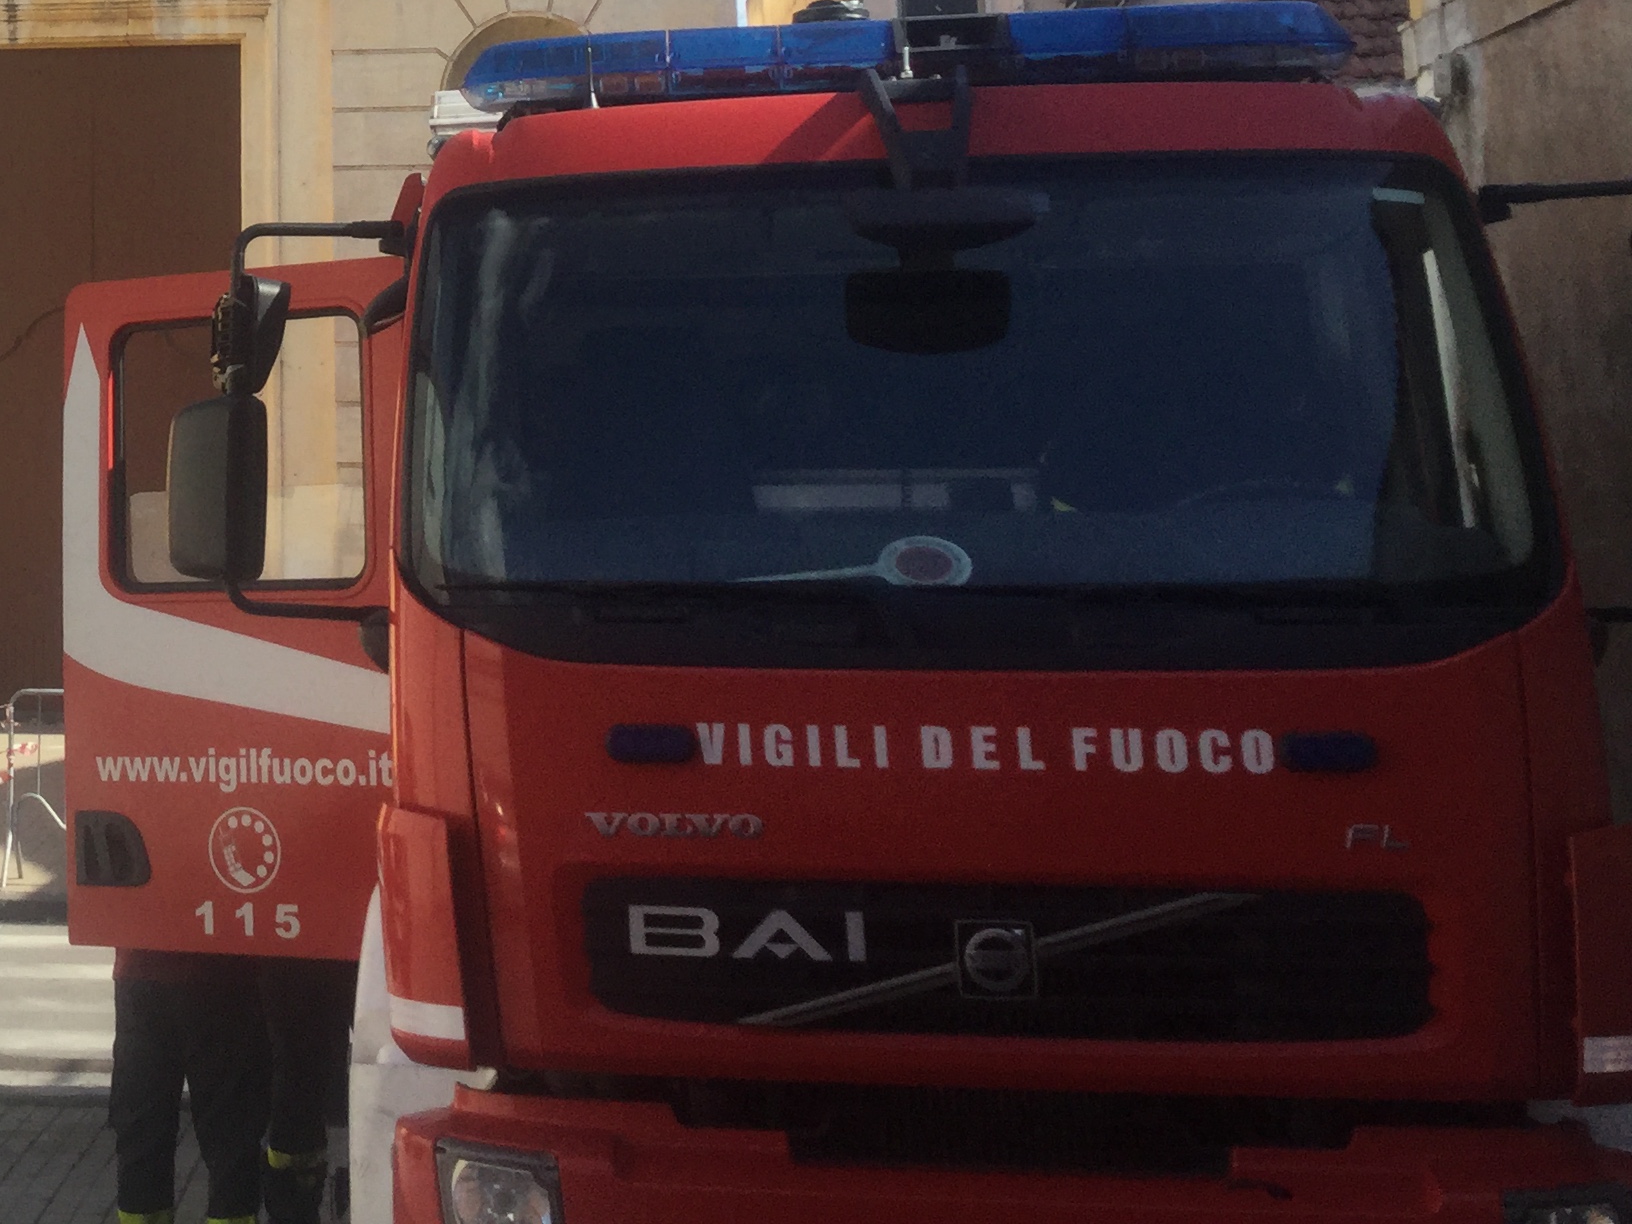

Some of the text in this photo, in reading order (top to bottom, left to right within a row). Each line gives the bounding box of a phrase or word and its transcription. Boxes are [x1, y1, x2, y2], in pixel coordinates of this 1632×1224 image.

[95, 747, 394, 793] www.vigilfuoco.it
[696, 722, 1275, 775] VIGILI DEL FUOCO
[585, 811, 765, 839] VOLVO
[628, 904, 867, 963] BAI
